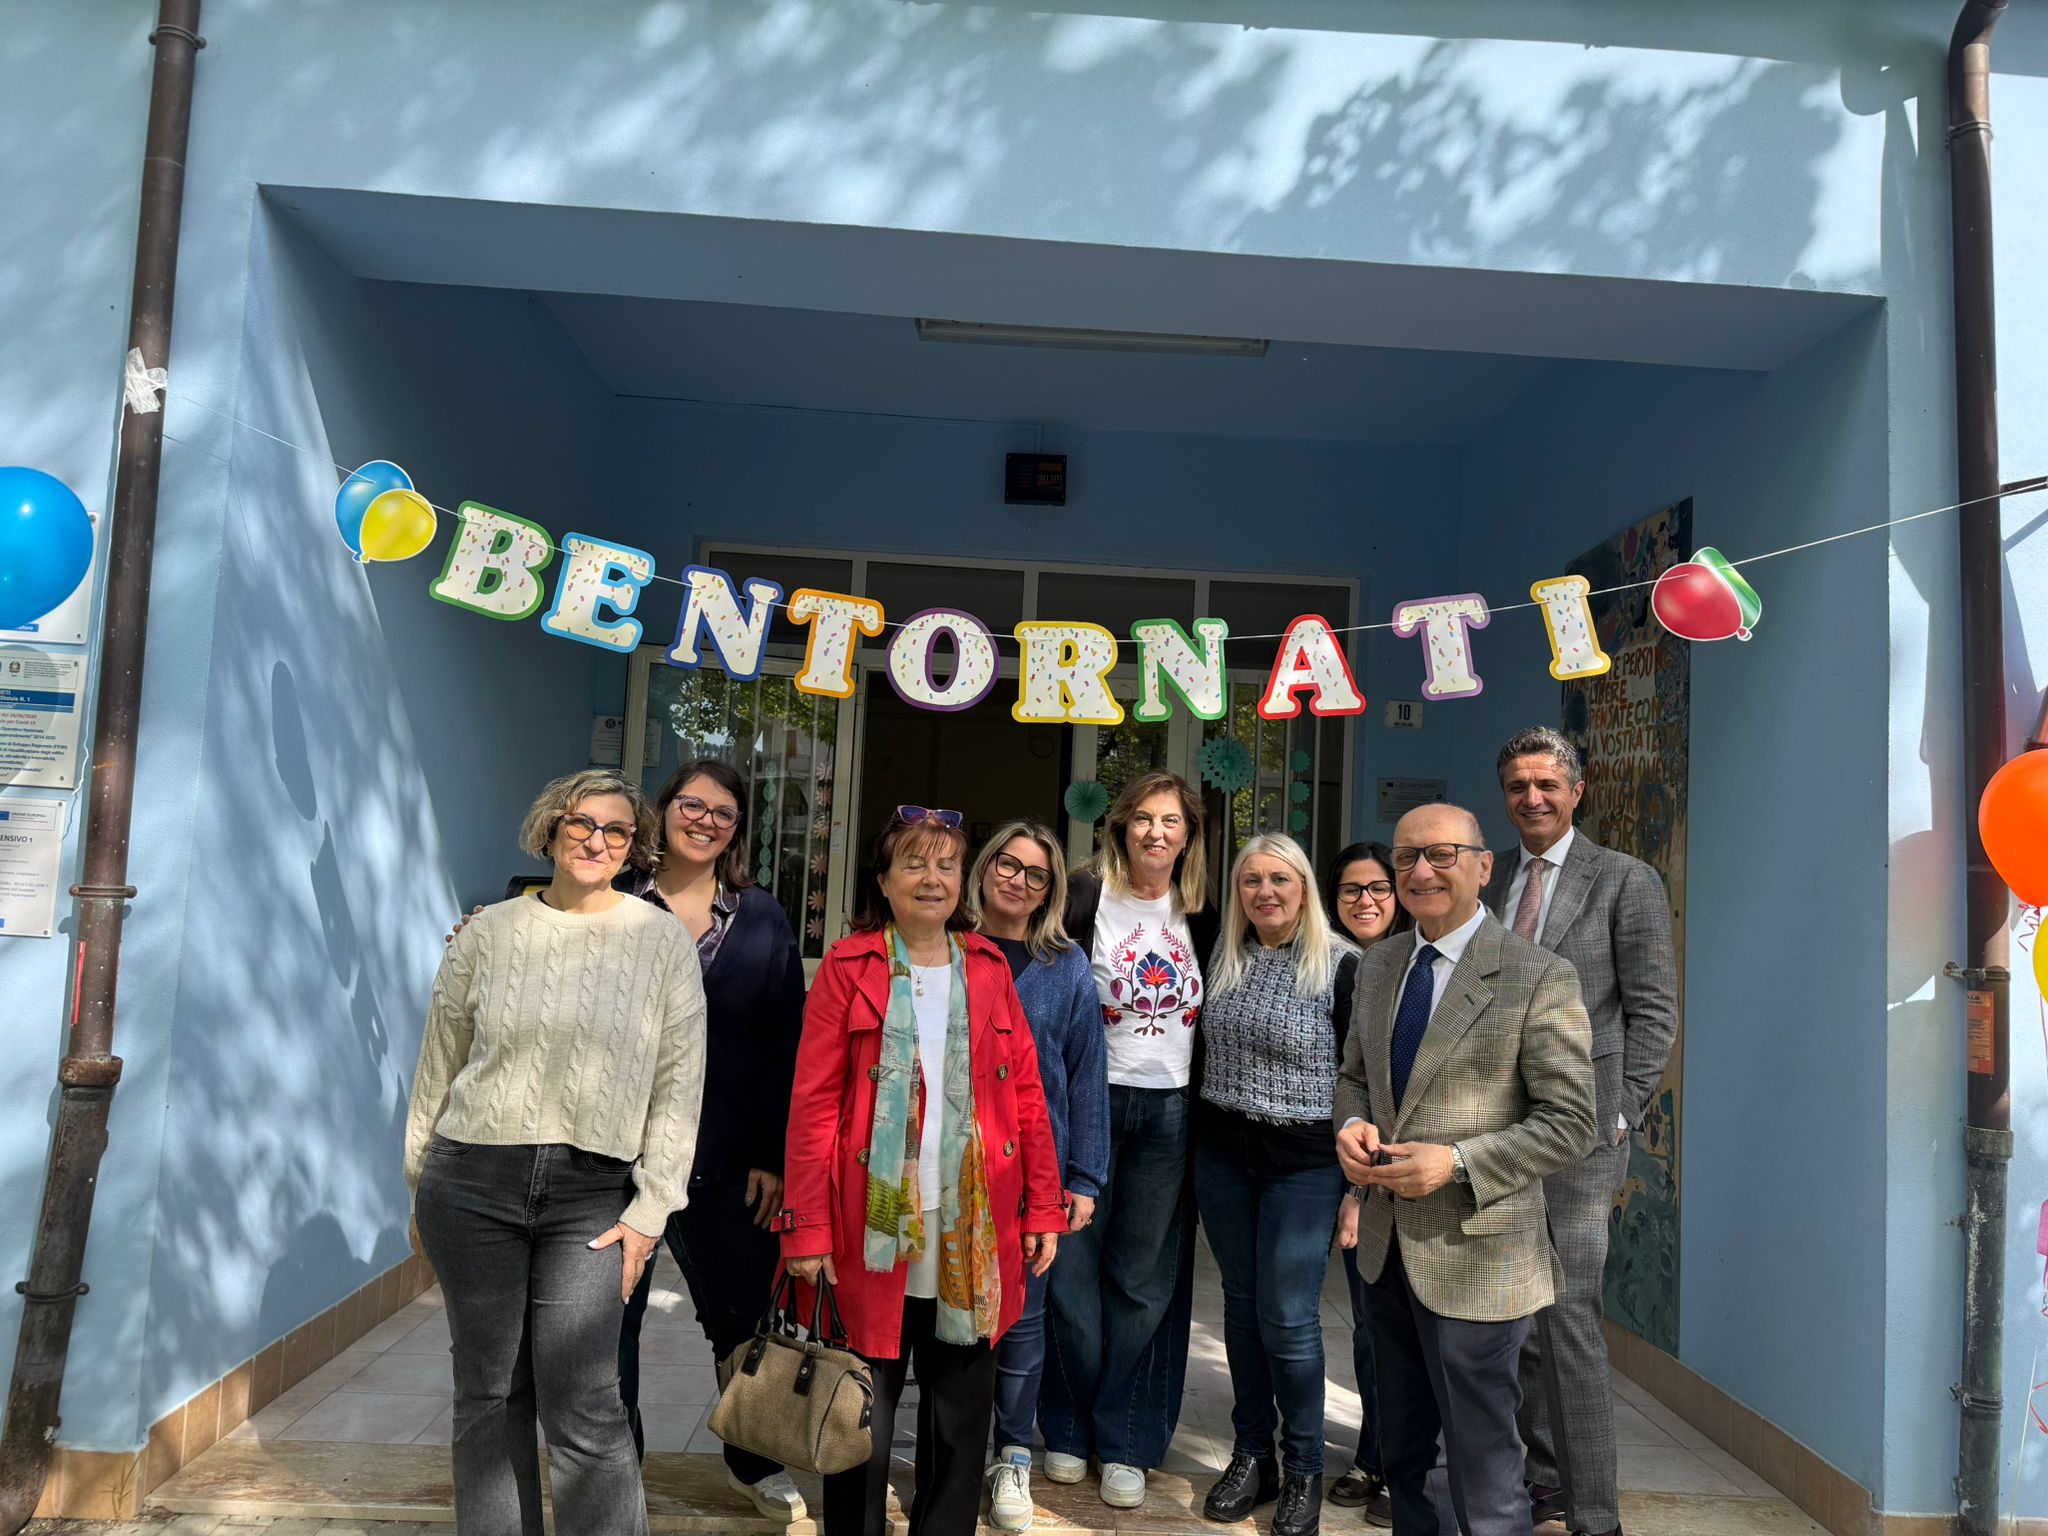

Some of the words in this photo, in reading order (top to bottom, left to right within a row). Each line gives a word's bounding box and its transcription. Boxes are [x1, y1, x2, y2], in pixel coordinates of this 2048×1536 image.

[429, 500, 1611, 724] BENTORNATI
[1589, 677, 1627, 704] LIBERE
[1398, 704, 1411, 721] 10
[1588, 701, 1634, 731] PENSATE
[1634, 696, 1661, 726] CON
[1599, 725, 1644, 756] VOSTRA
[1584, 758, 1609, 786] NON
[1612, 756, 1635, 782] CON
